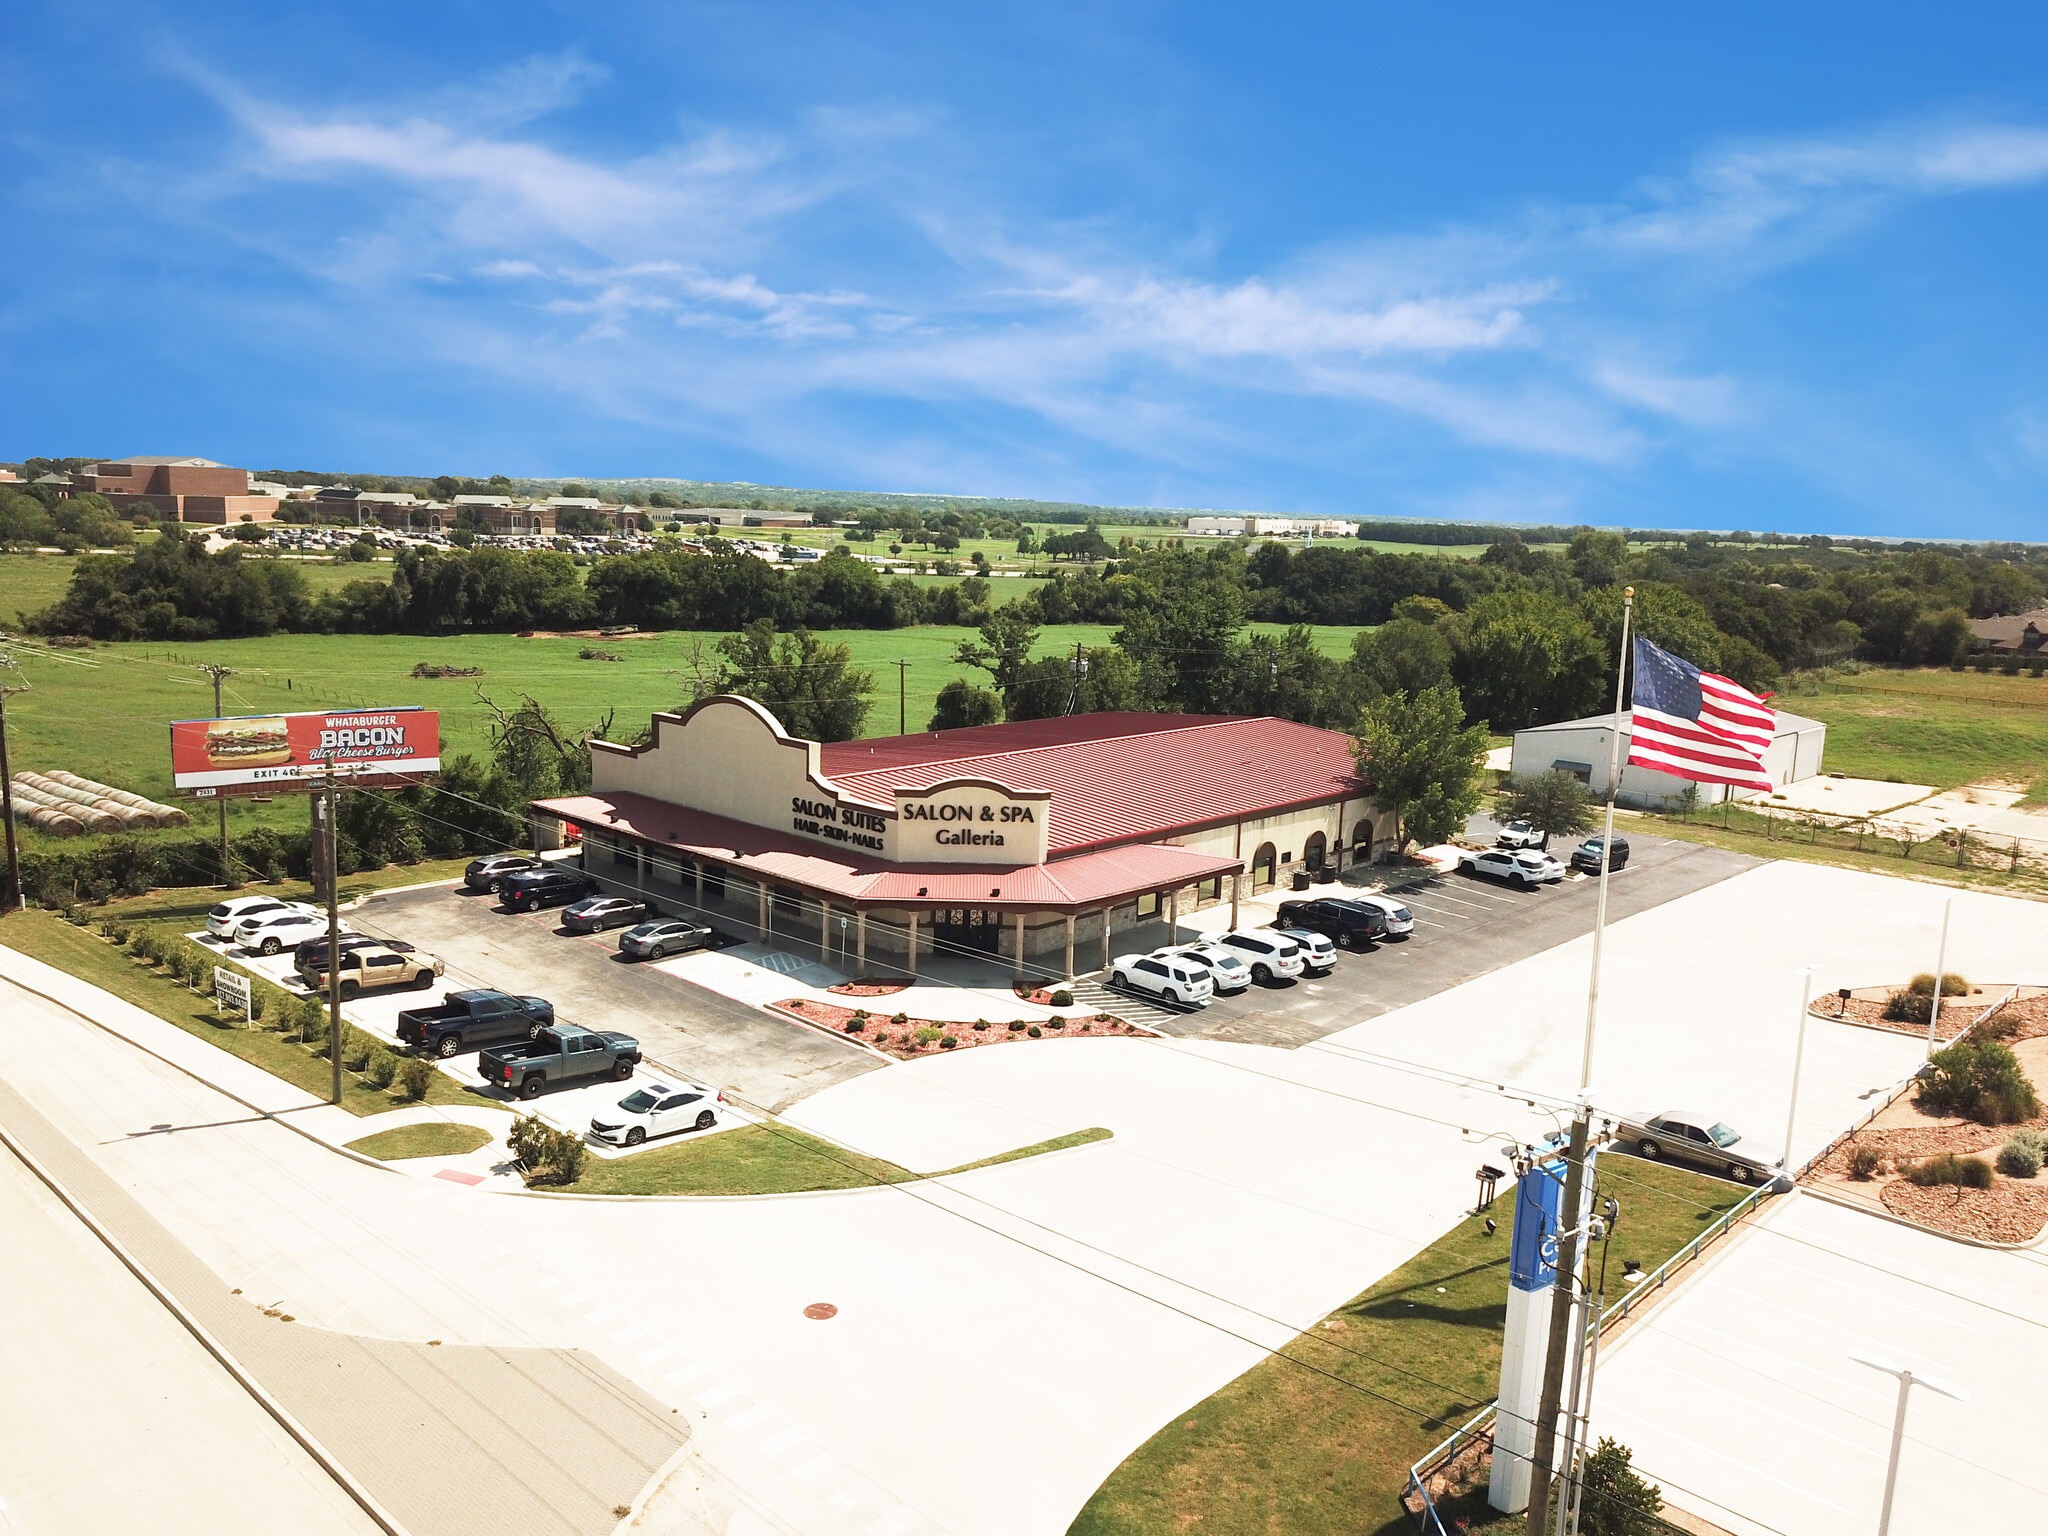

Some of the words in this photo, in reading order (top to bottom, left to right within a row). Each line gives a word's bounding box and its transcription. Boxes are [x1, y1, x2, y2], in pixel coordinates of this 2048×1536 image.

[325, 715, 398, 728] WHATABURGER
[320, 727, 405, 748] BACON
[337, 746, 374, 758] Cheese
[375, 745, 415, 758] Burger
[253, 769, 279, 779] EXIT
[792, 797, 837, 821] SALON
[841, 809, 886, 833] SUITES
[903, 803, 973, 821] SALON
[980, 805, 995, 822] &
[1000, 806, 1035, 823] SPA
[935, 828, 1005, 846] Galleria
[219, 970, 236, 984] RETAIL
[236, 977, 242, 986] &
[216, 979, 247, 999] SHOWROOM
